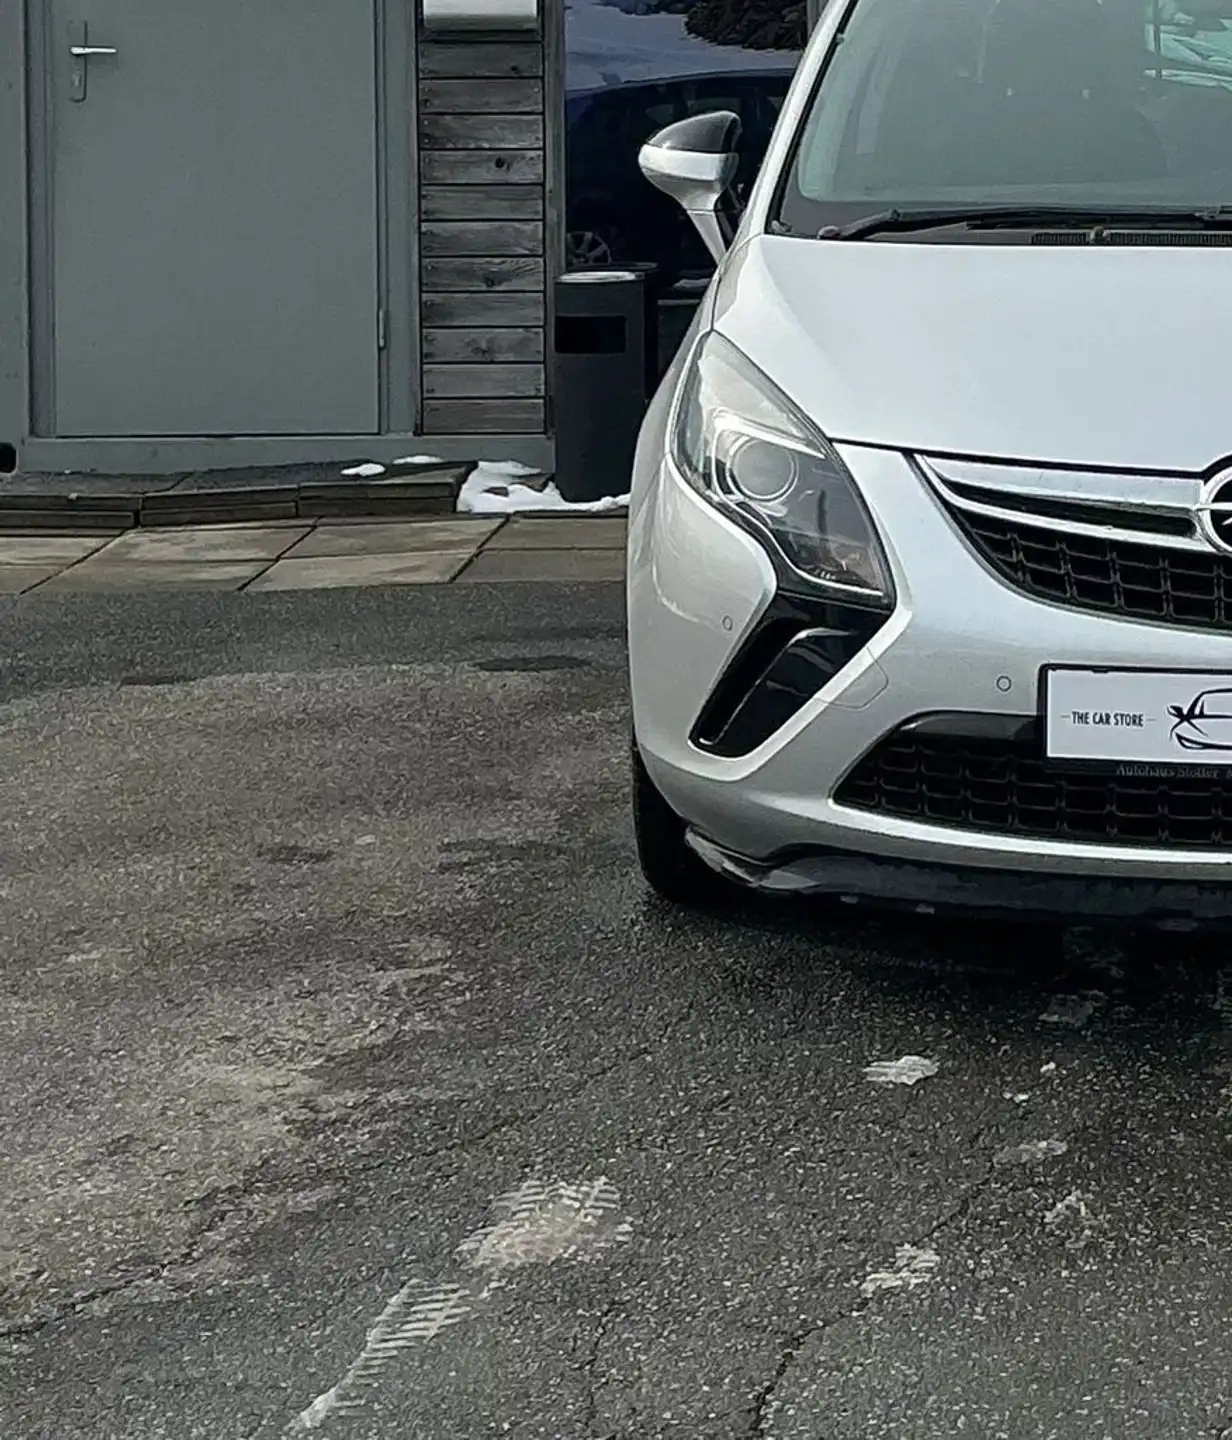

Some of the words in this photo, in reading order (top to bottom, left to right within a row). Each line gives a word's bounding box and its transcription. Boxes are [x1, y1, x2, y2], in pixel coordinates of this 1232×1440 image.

[1072, 711, 1090, 725] THE
[1092, 712, 1111, 726] CAR
[1113, 713, 1144, 727] STORE
